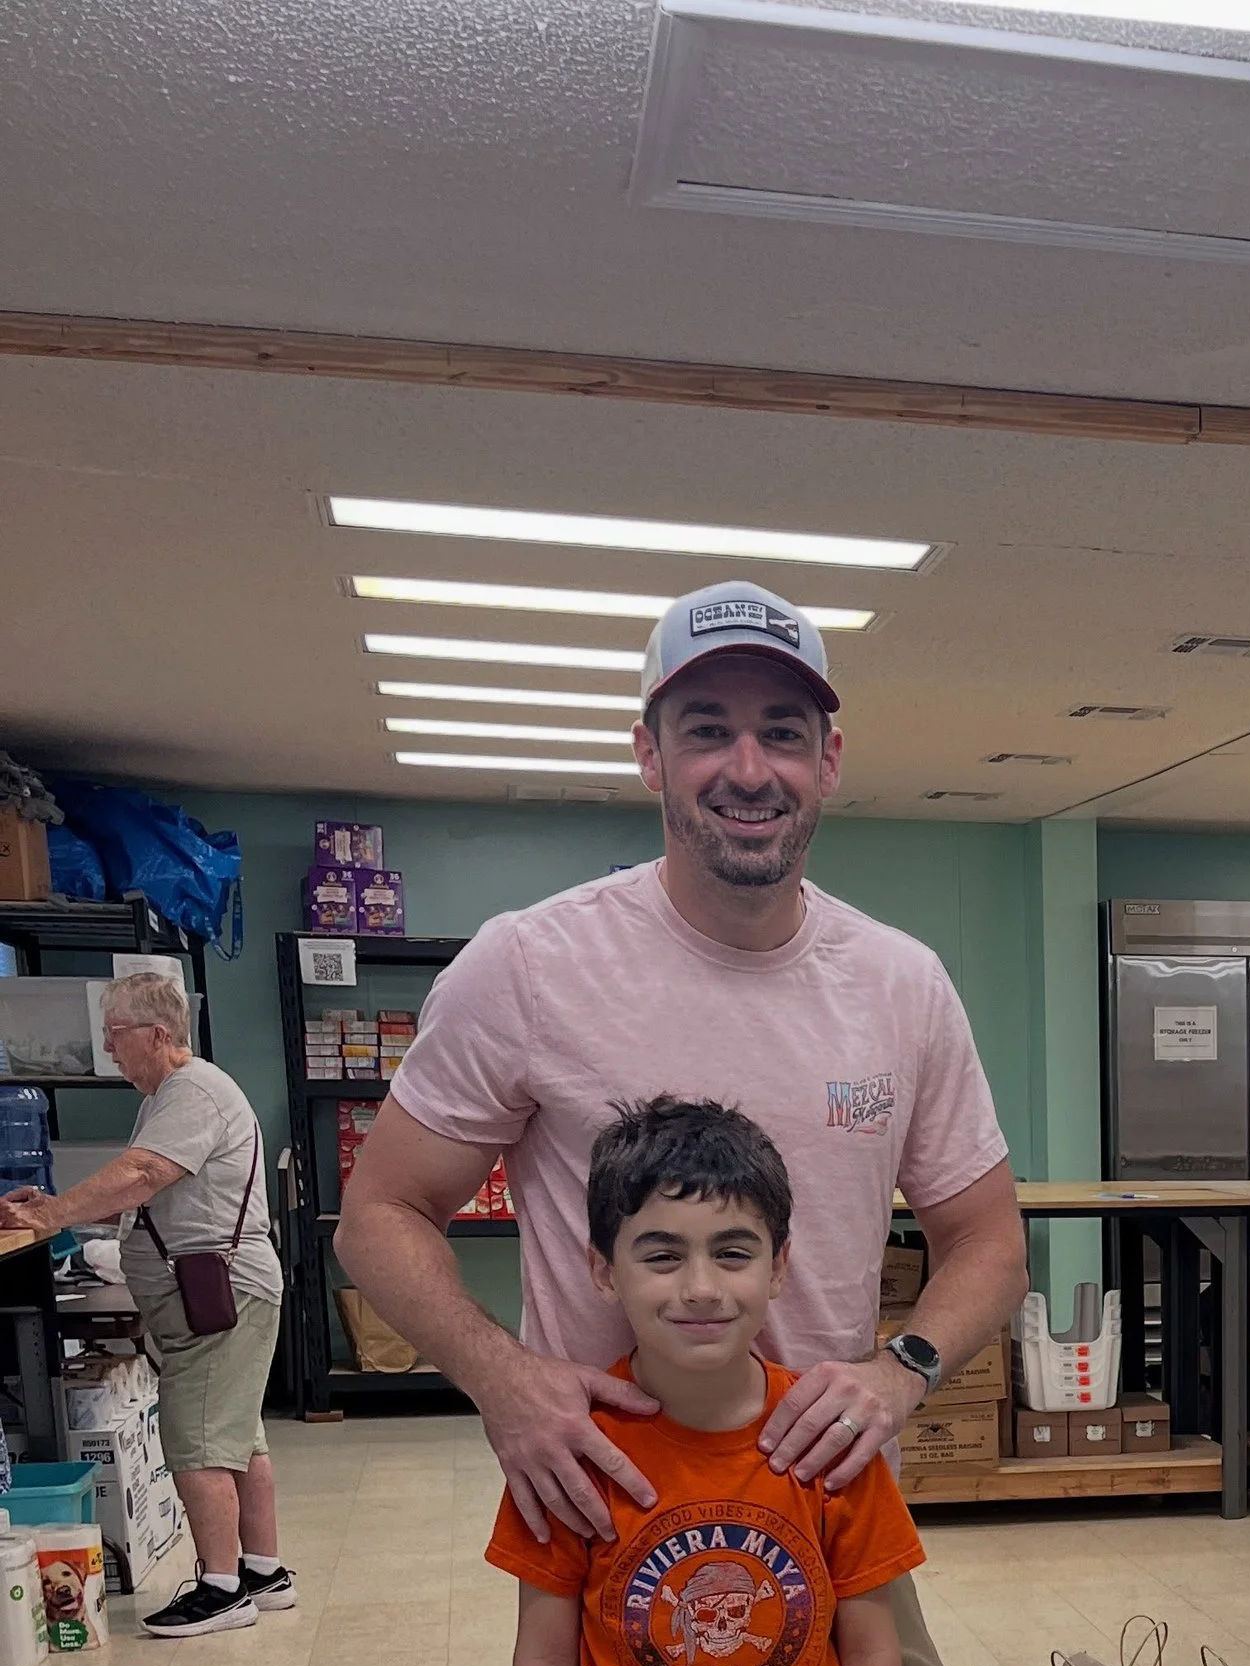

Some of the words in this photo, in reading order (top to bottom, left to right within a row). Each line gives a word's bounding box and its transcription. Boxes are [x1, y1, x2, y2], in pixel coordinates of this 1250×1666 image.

[695, 604, 746, 623] OCEAN
[826, 1078, 894, 1128] MEZCAL
[699, 1504, 744, 1520] VIBES
[626, 1526, 729, 1610] RIVIERA
[741, 1529, 806, 1600] MAYA
